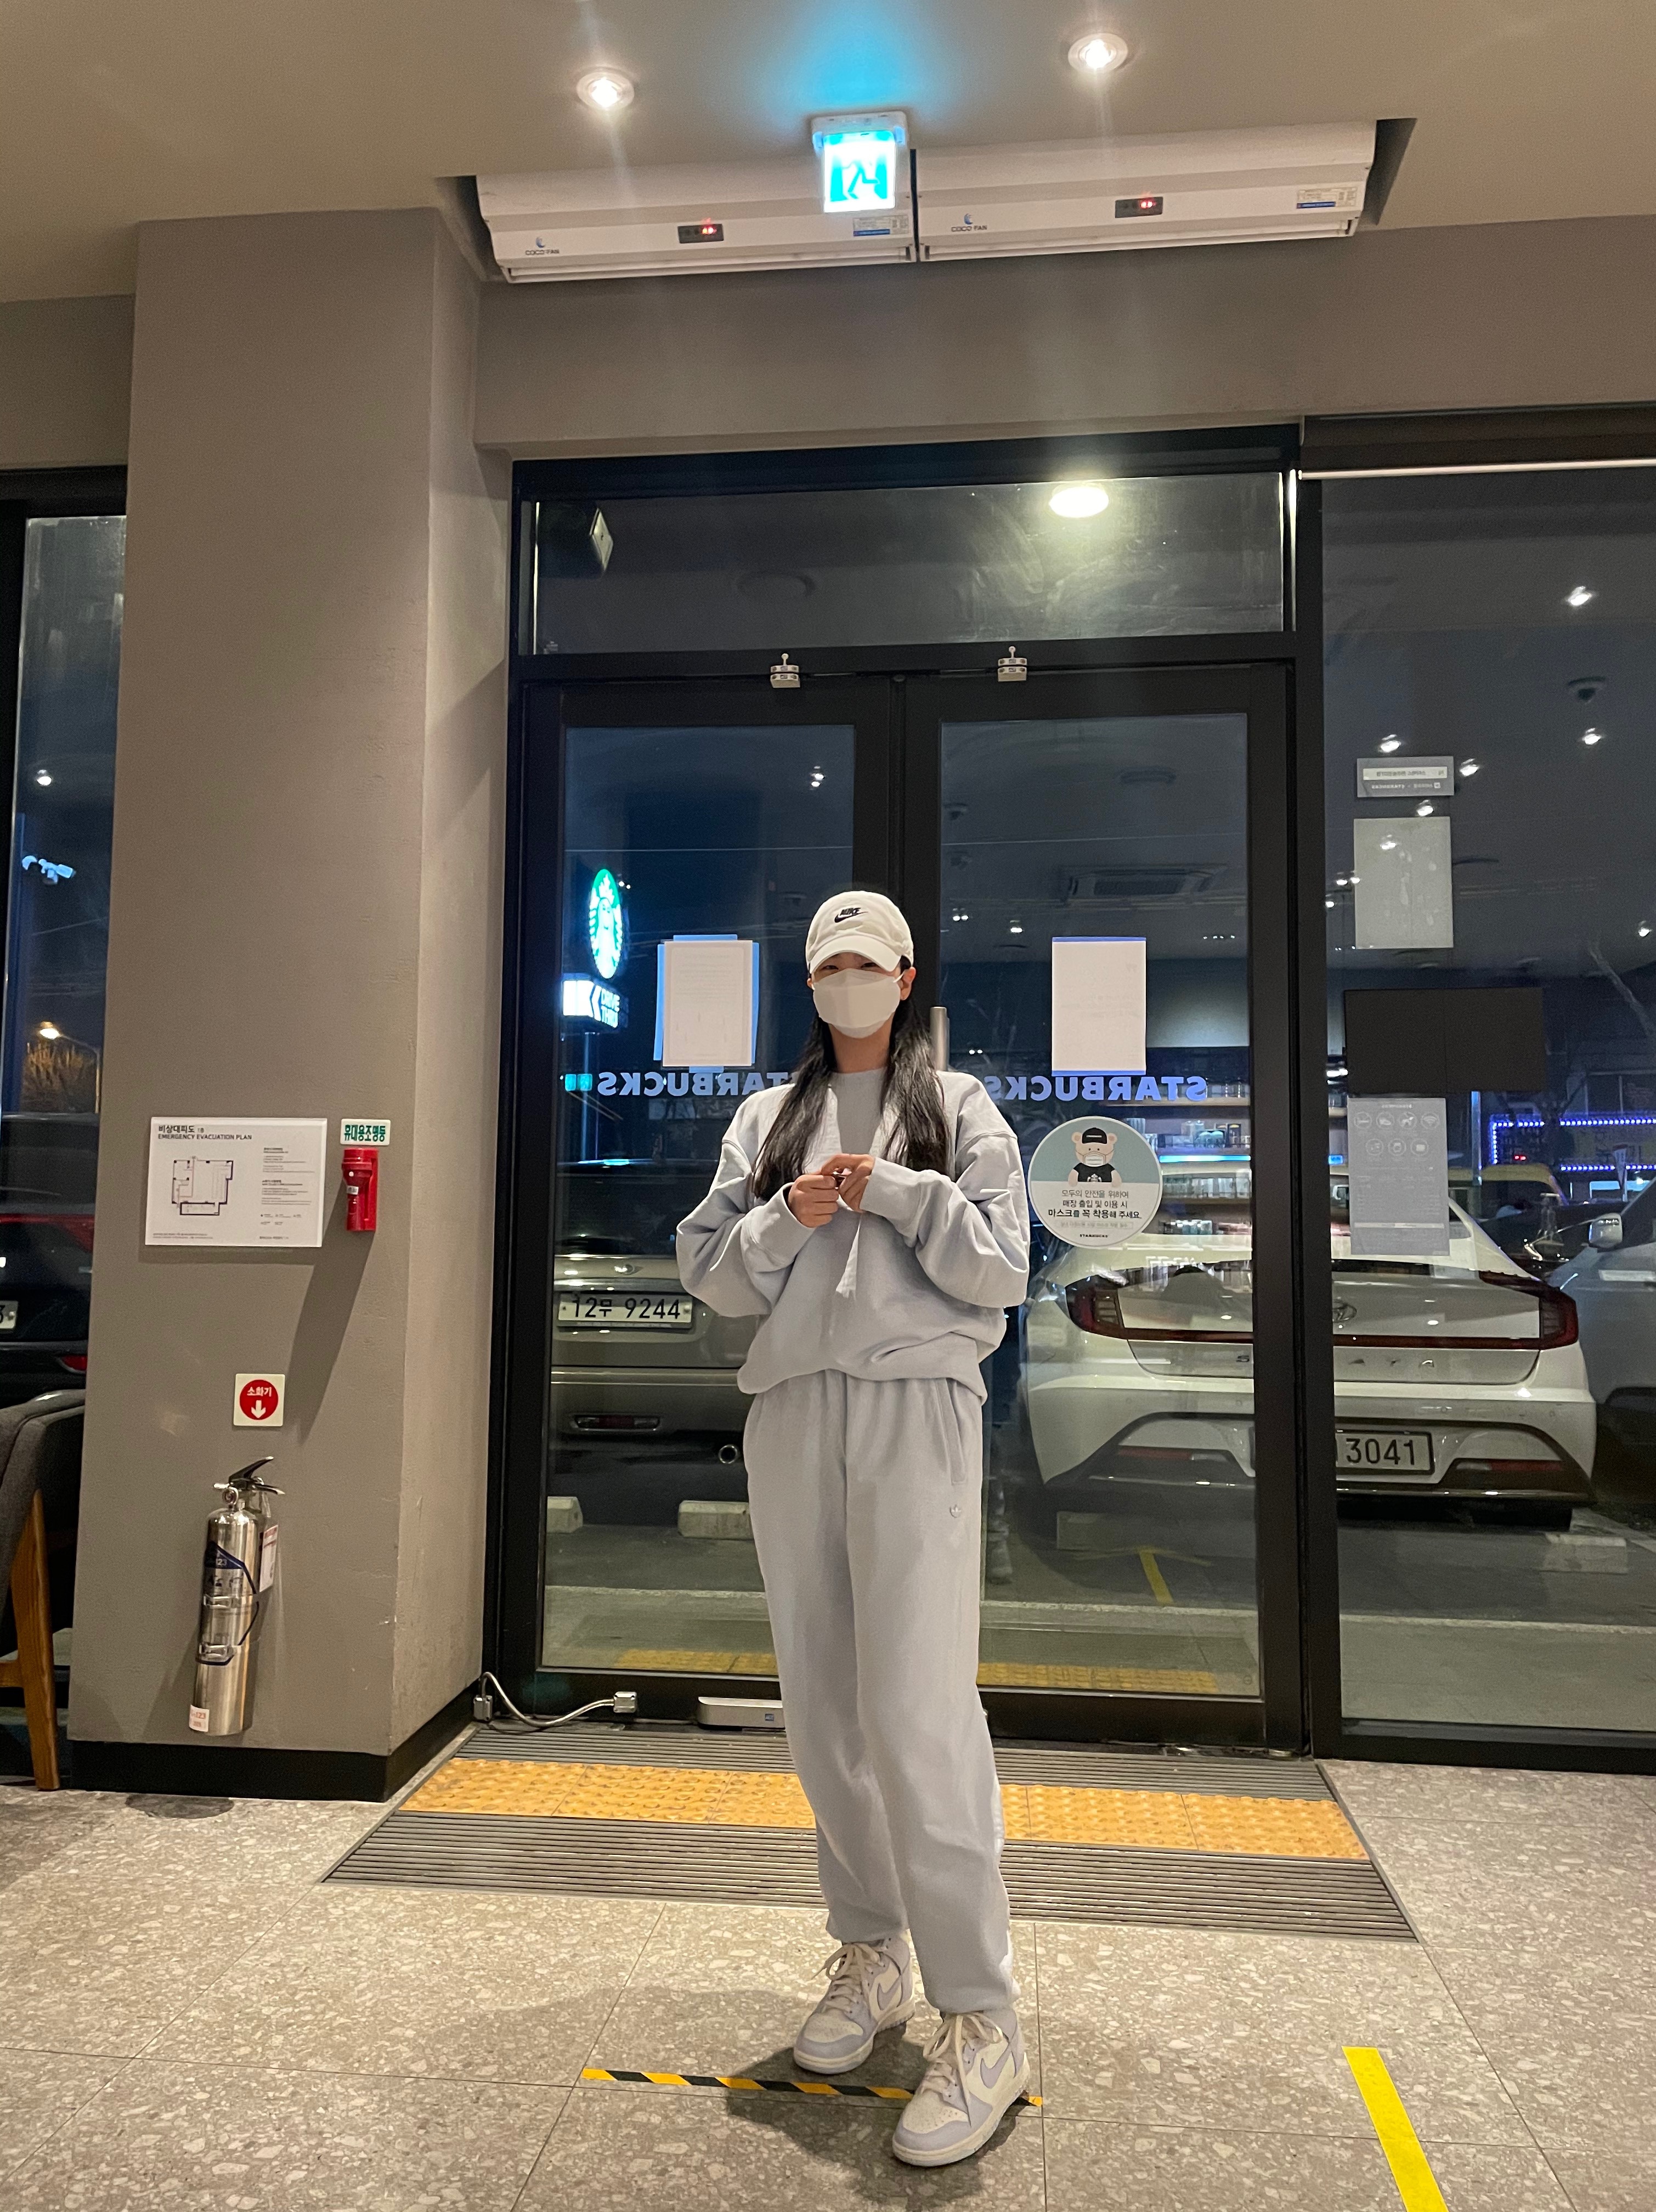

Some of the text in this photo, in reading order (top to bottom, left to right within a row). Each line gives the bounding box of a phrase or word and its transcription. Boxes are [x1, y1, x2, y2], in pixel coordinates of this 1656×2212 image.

[840, 907, 861, 916] NIKE
[601, 988, 620, 1013] DRIVE
[601, 1005, 618, 1028] THRU
[158, 1125, 195, 1133] 비상대피도
[344, 1124, 386, 1142] 휴대용조명등
[1085, 1190, 1105, 1198] 안전을
[1108, 1190, 1129, 1199] 위하여
[1062, 1200, 1077, 1208] 매장
[1079, 1200, 1093, 1208] 출입
[1104, 1200, 1118, 1209] 이용
[1048, 1209, 1079, 1218] 마스크를
[1082, 1210, 1090, 1218] 꼭
[1093, 1210, 1116, 1218] 착용해
[625, 1297, 680, 1319] 9244
[246, 1386, 272, 1397] 소화기
[1346, 1438, 1415, 1465] 3041
